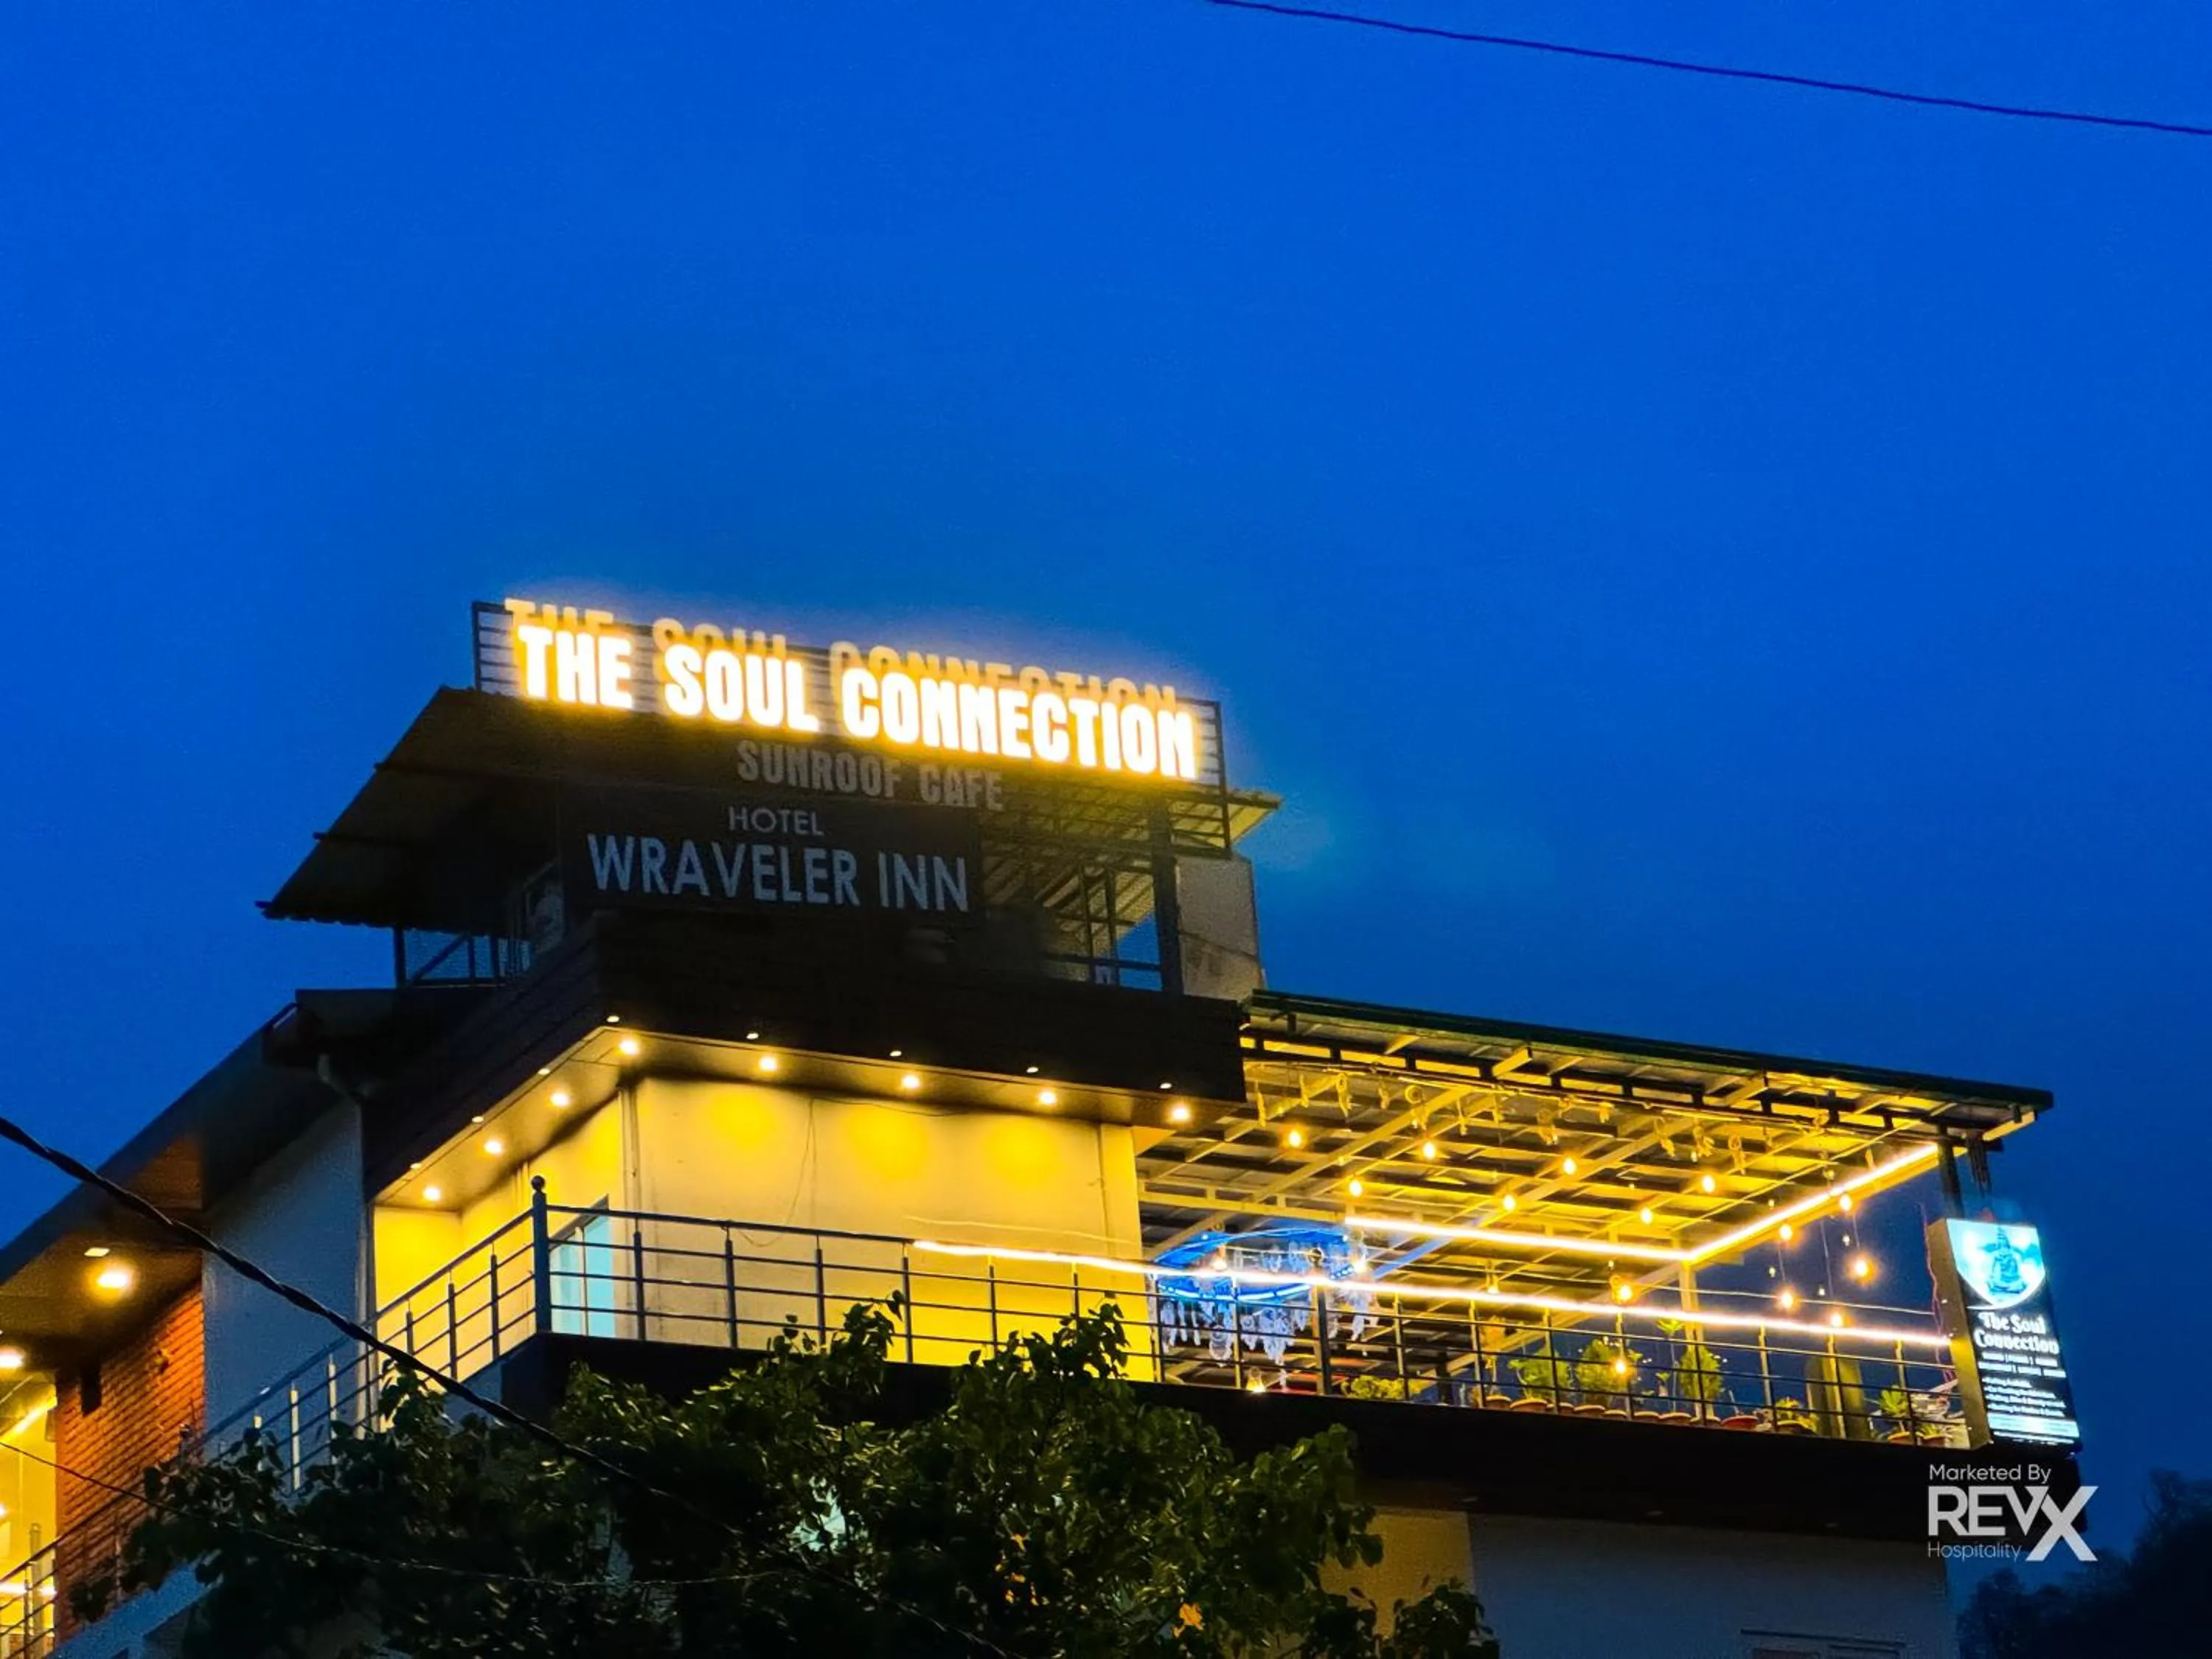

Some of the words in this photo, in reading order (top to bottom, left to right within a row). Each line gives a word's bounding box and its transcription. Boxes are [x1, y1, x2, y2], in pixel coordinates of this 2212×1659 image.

[517, 624, 633, 709] THE
[664, 643, 820, 733] SOUL
[841, 668, 1196, 780] CONNECTION
[737, 740, 902, 799] SUNROOF
[918, 763, 1004, 811] CAFE
[728, 806, 824, 837] HOTEL
[587, 833, 860, 907] WRAVELER
[877, 851, 969, 913] INN
[1973, 1327, 2060, 1354] Connection
[1978, 1312, 2010, 1331] The
[2010, 1314, 2046, 1335] Soul
